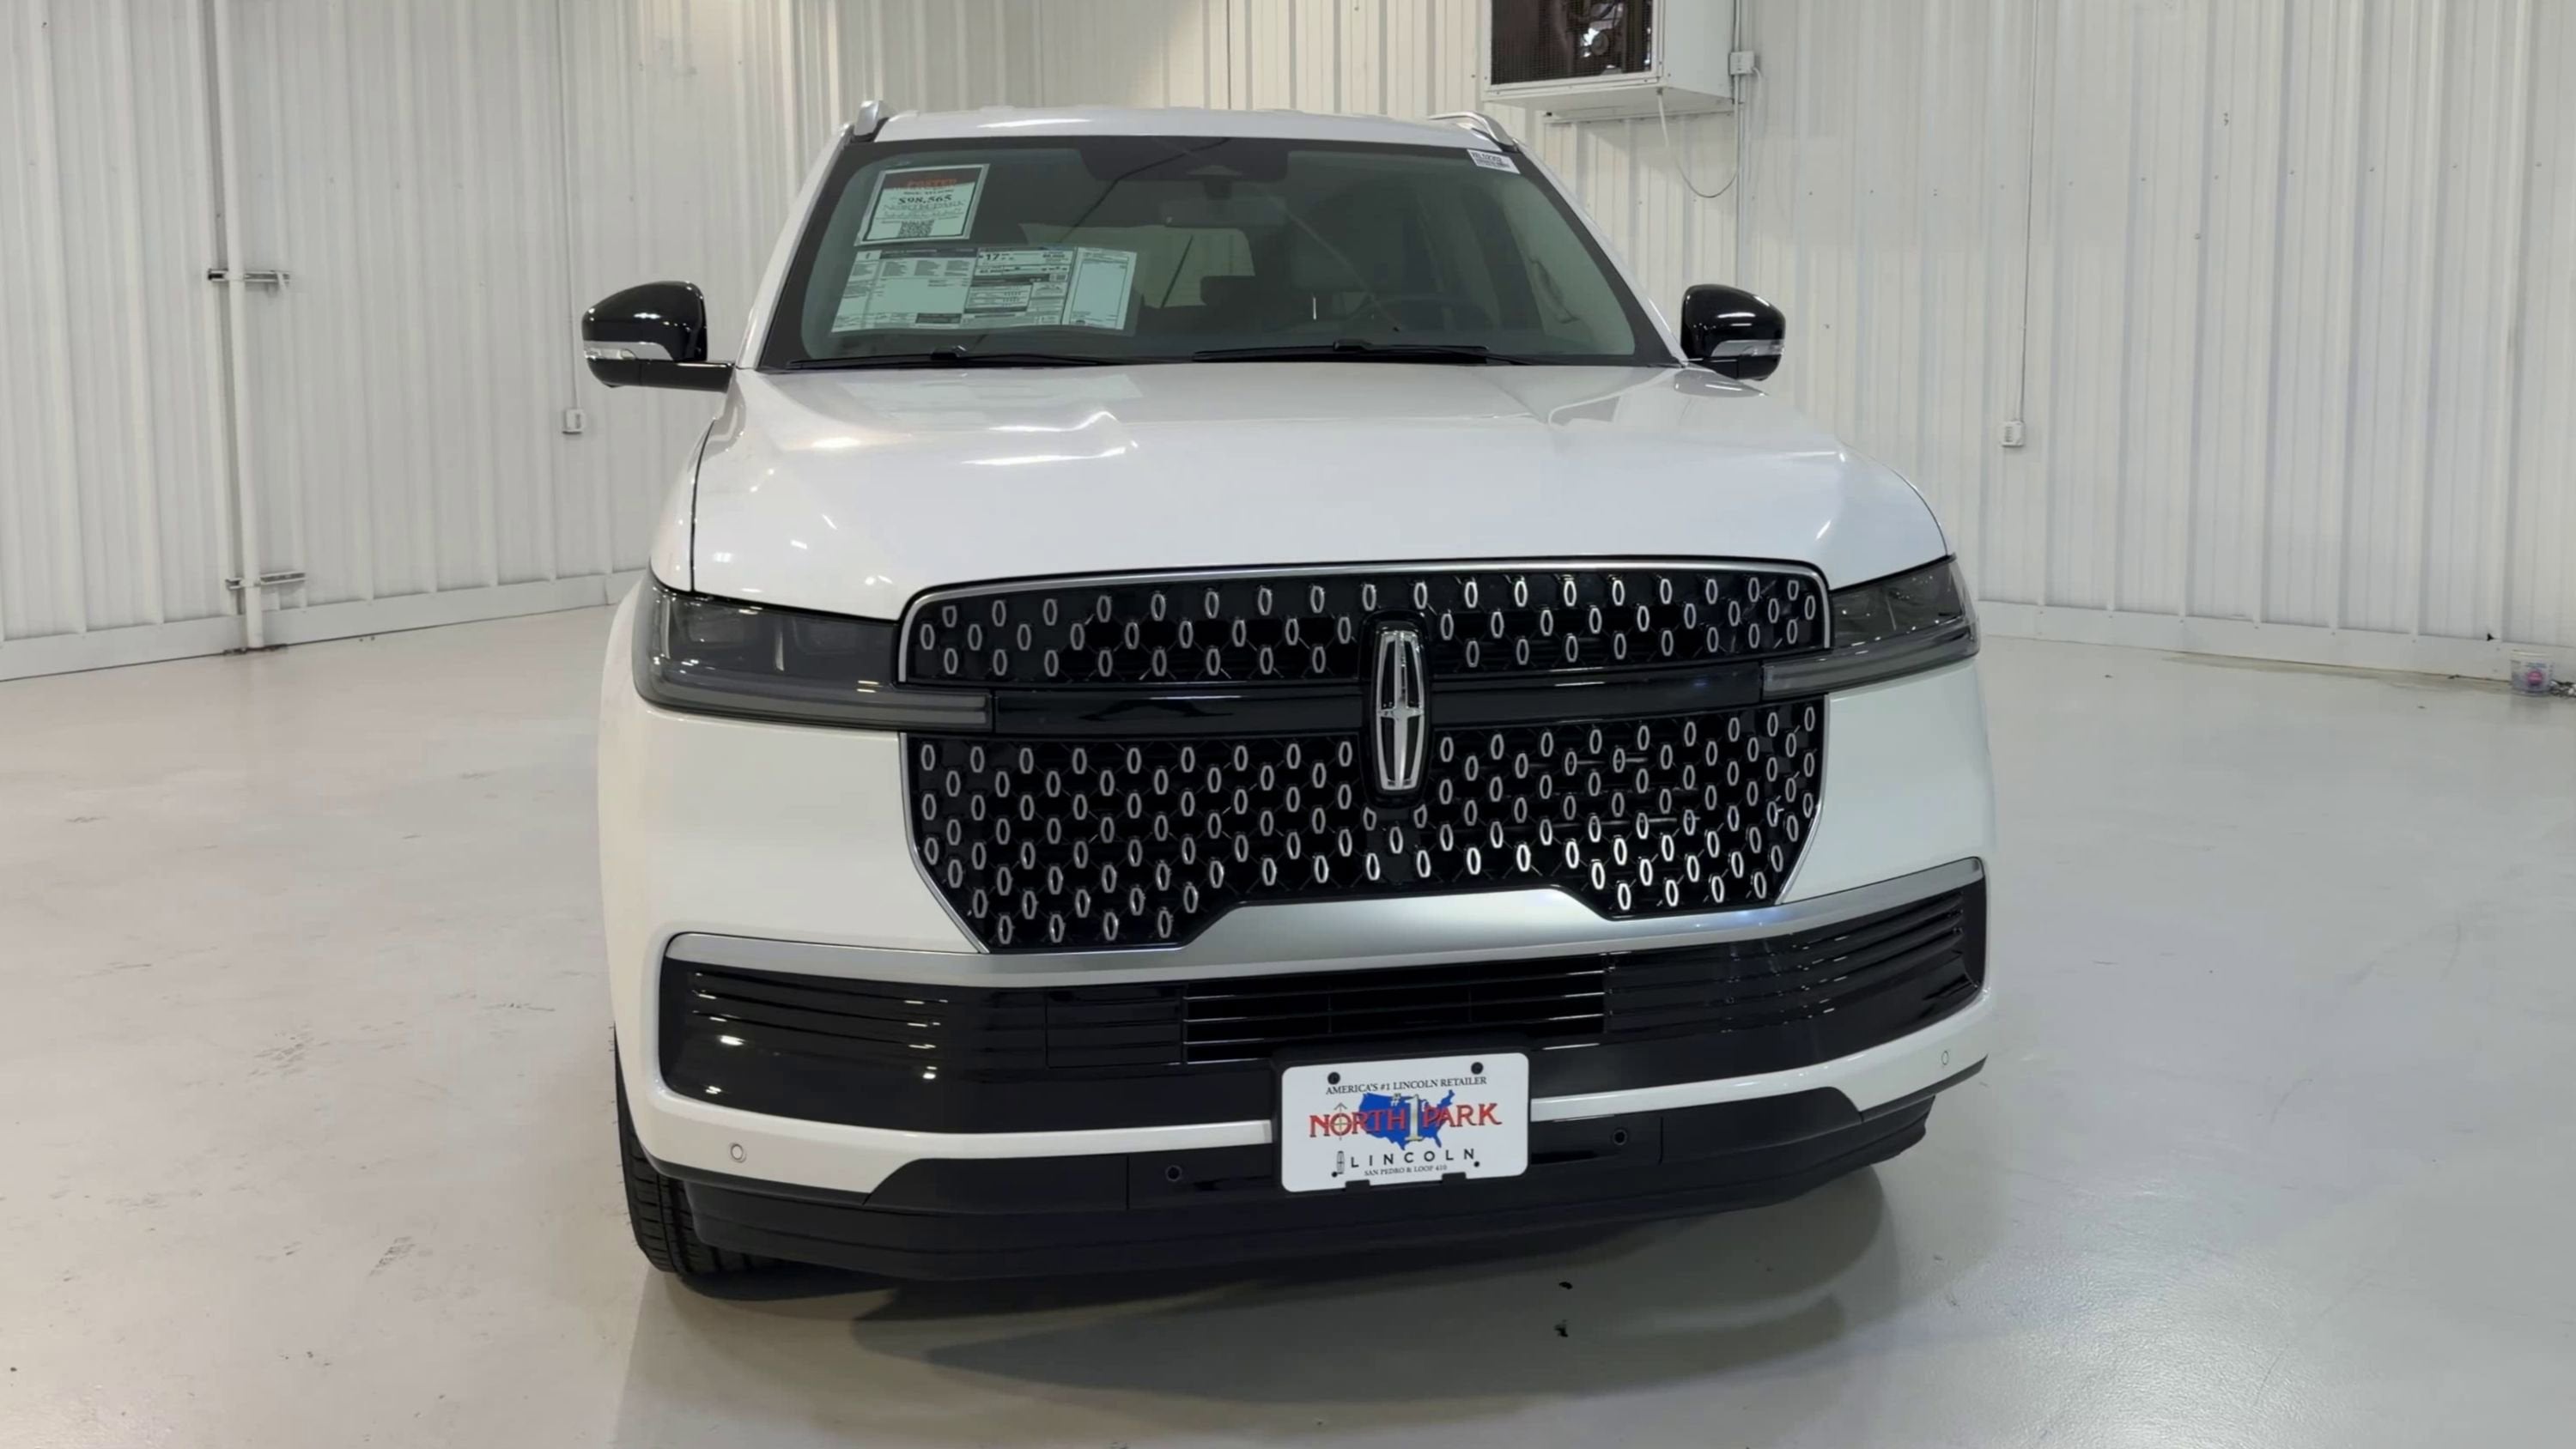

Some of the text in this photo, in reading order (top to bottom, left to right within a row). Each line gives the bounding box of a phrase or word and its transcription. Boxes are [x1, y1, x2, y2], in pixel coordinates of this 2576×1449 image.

[1326, 1076, 1487, 1094] AMERICA'S #1 LINCOLN RETAILER
[1309, 1102, 1503, 1138] NORTH PARK
[1351, 1149, 1474, 1168] LINCOLN
